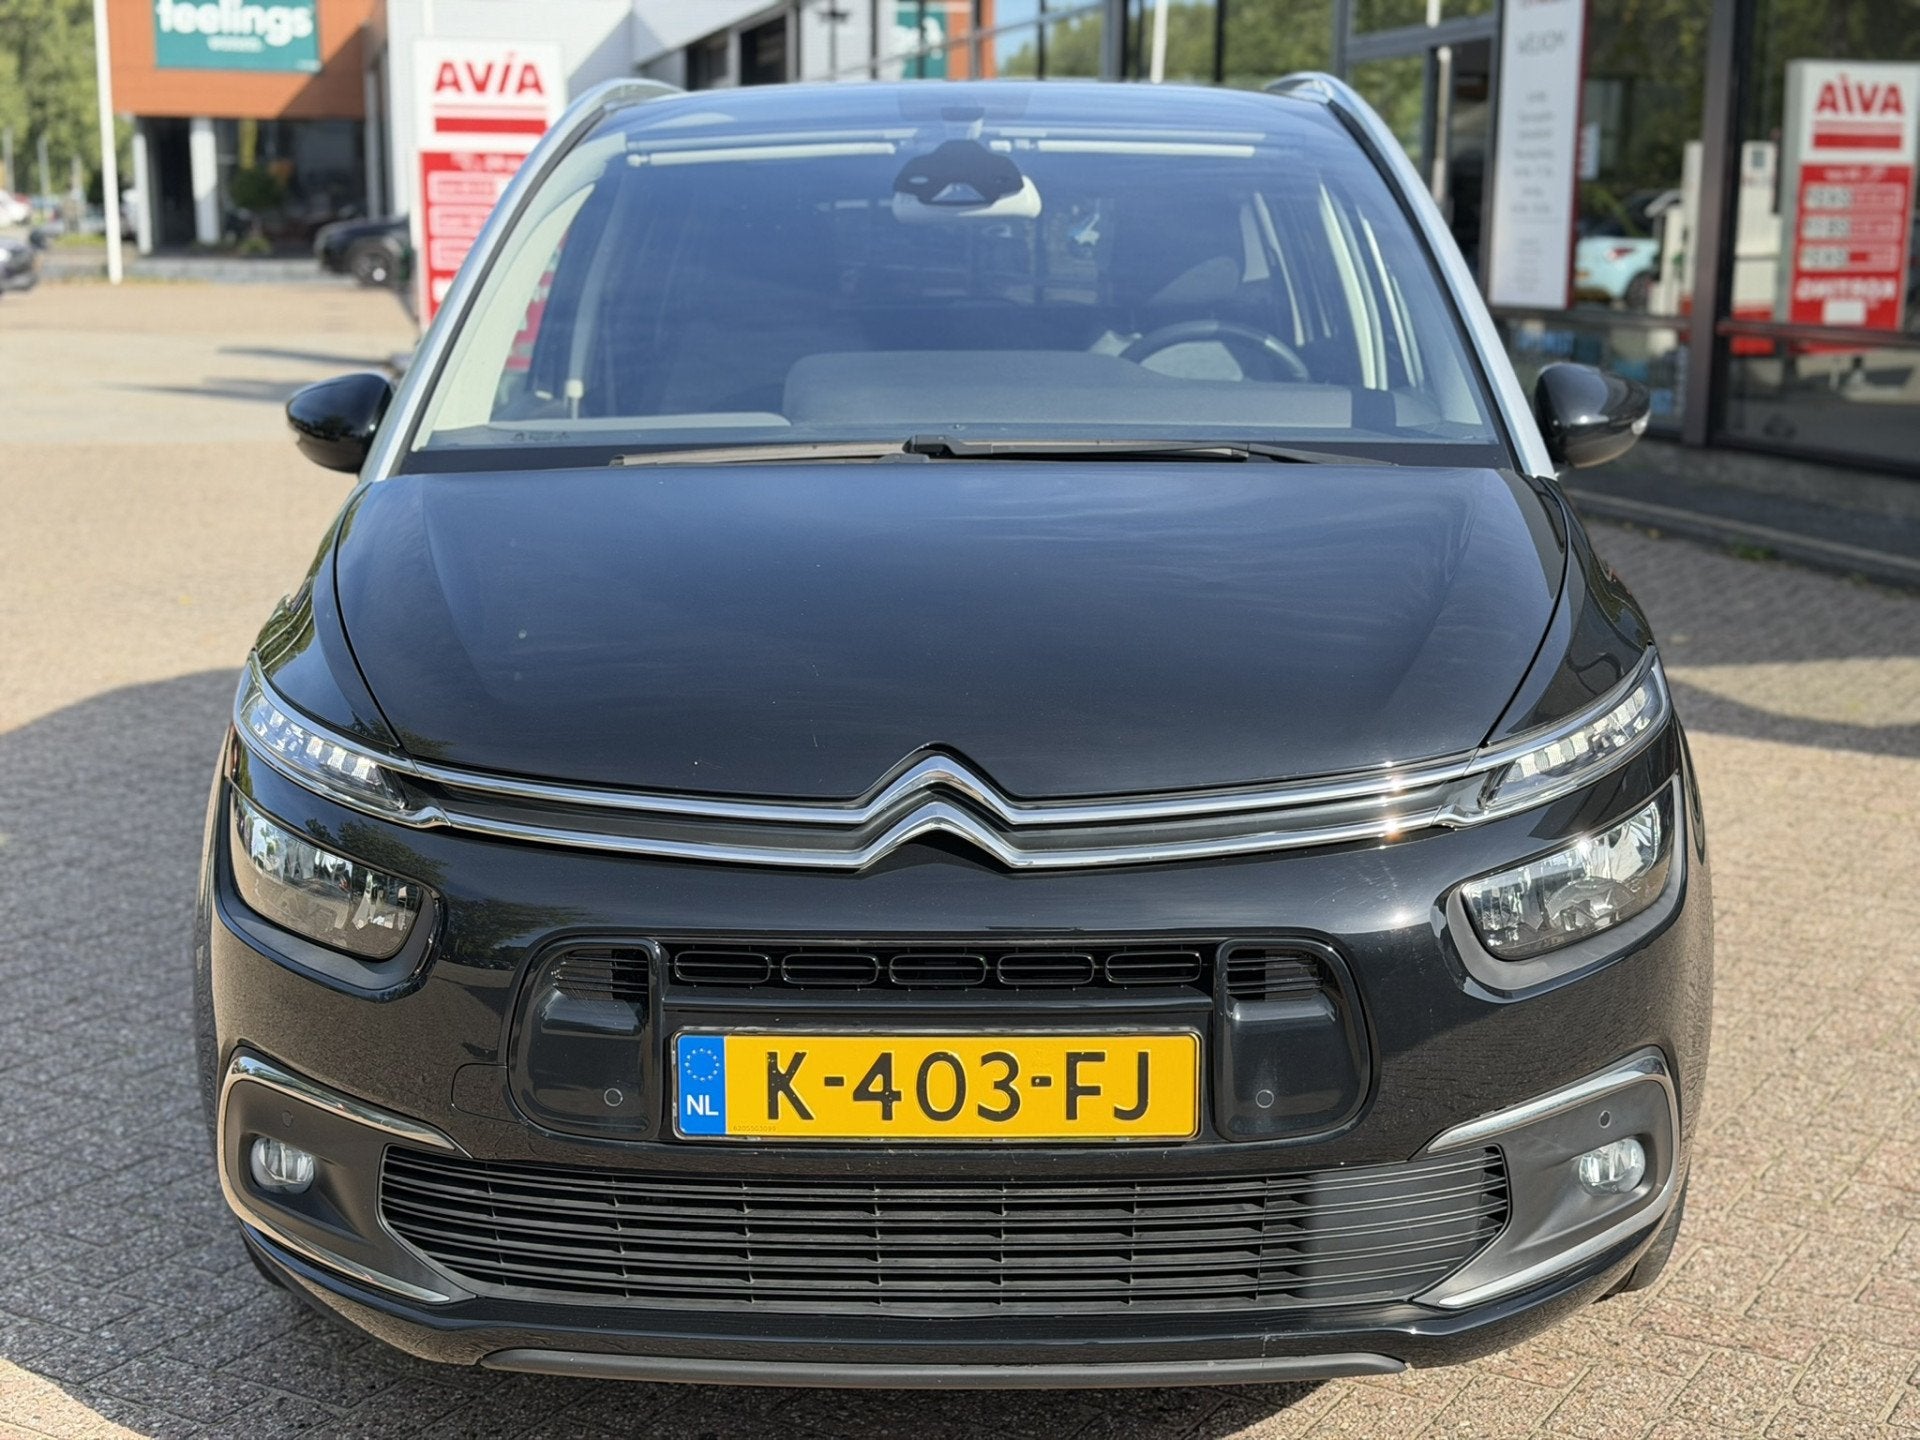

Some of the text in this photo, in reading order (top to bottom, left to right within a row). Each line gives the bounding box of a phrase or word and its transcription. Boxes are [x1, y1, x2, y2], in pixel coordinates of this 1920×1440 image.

[156, 0, 313, 46] feelings
[686, 1094, 719, 1116] NL
[766, 1051, 1151, 1121] K-403-FJ
